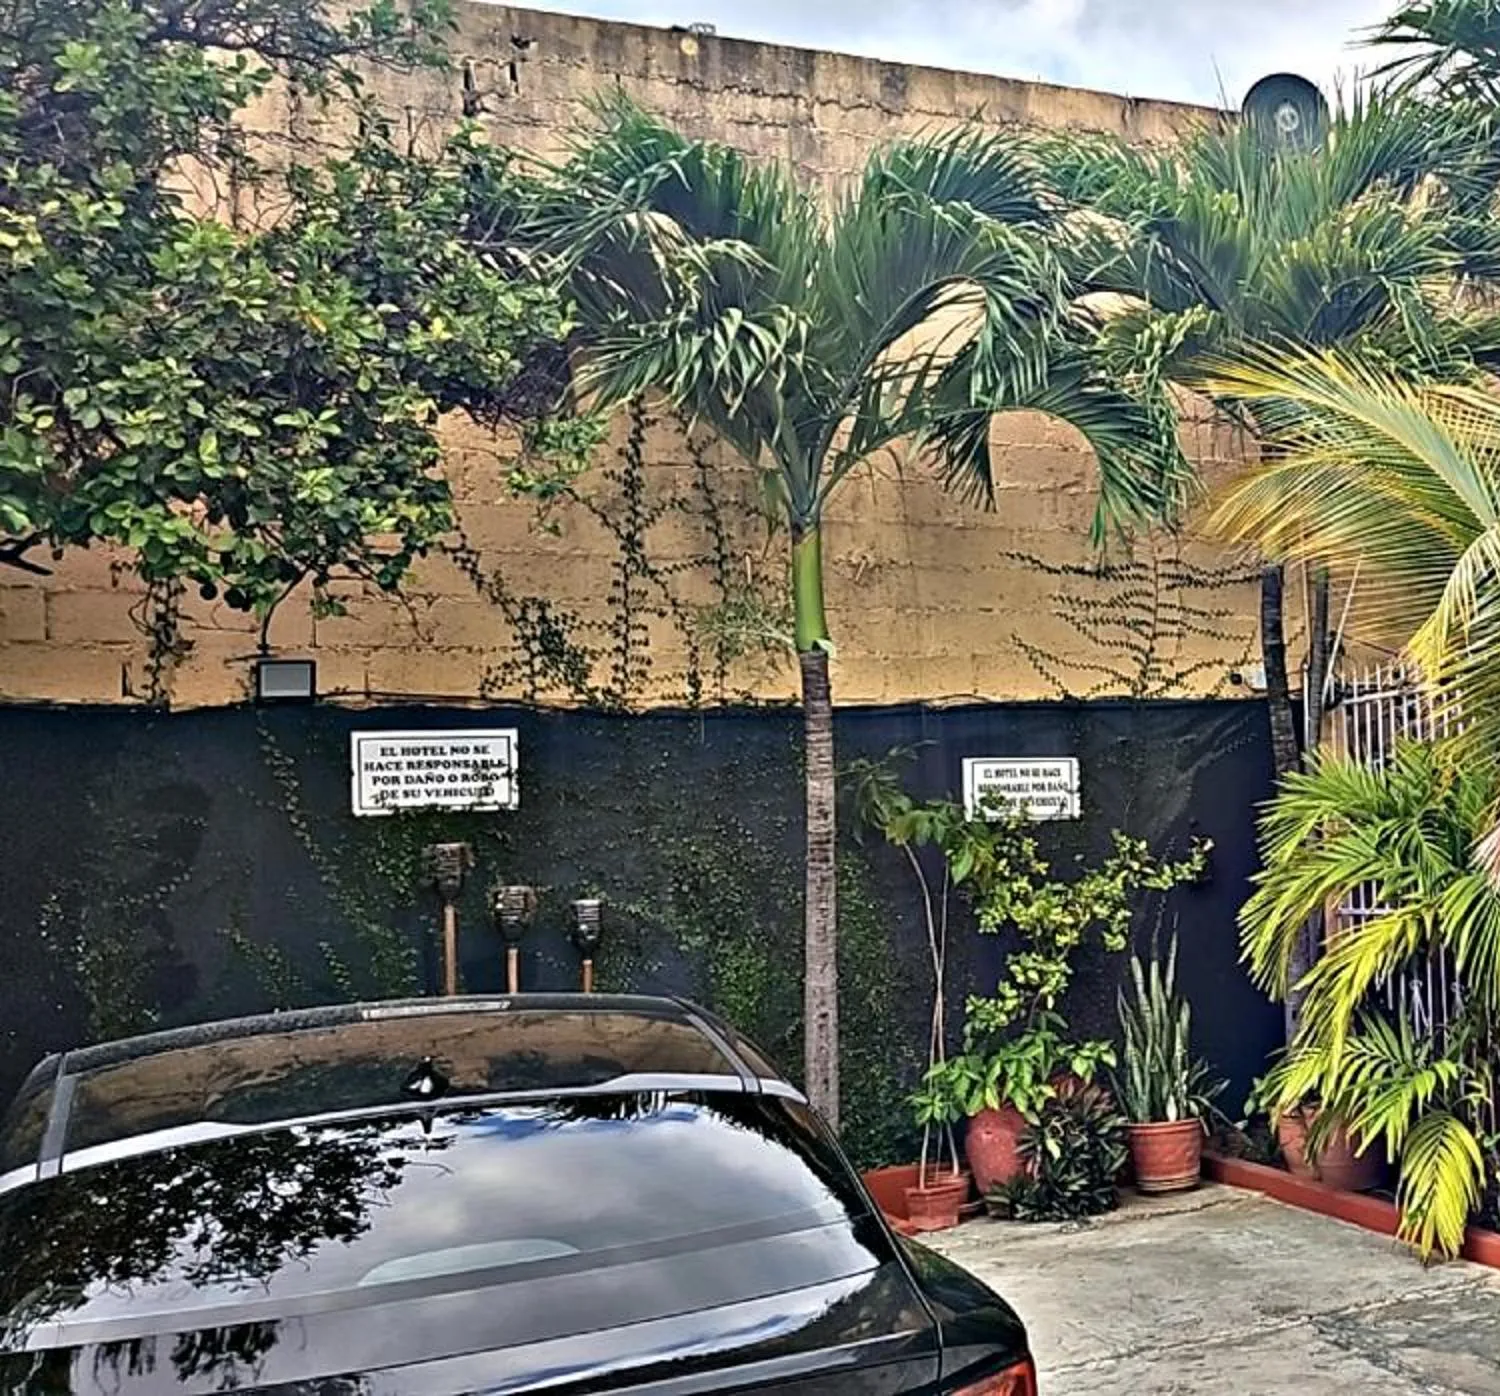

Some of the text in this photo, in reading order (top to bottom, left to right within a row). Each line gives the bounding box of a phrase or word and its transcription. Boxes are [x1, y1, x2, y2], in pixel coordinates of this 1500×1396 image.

[380, 745, 490, 757] EL HOTEL NO SE
[364, 759, 507, 772] HACE RESPONSABLE
[372, 772, 501, 786] POR DAÑO O ROBO
[379, 788, 400, 800] DE
[402, 787, 422, 799] SU
